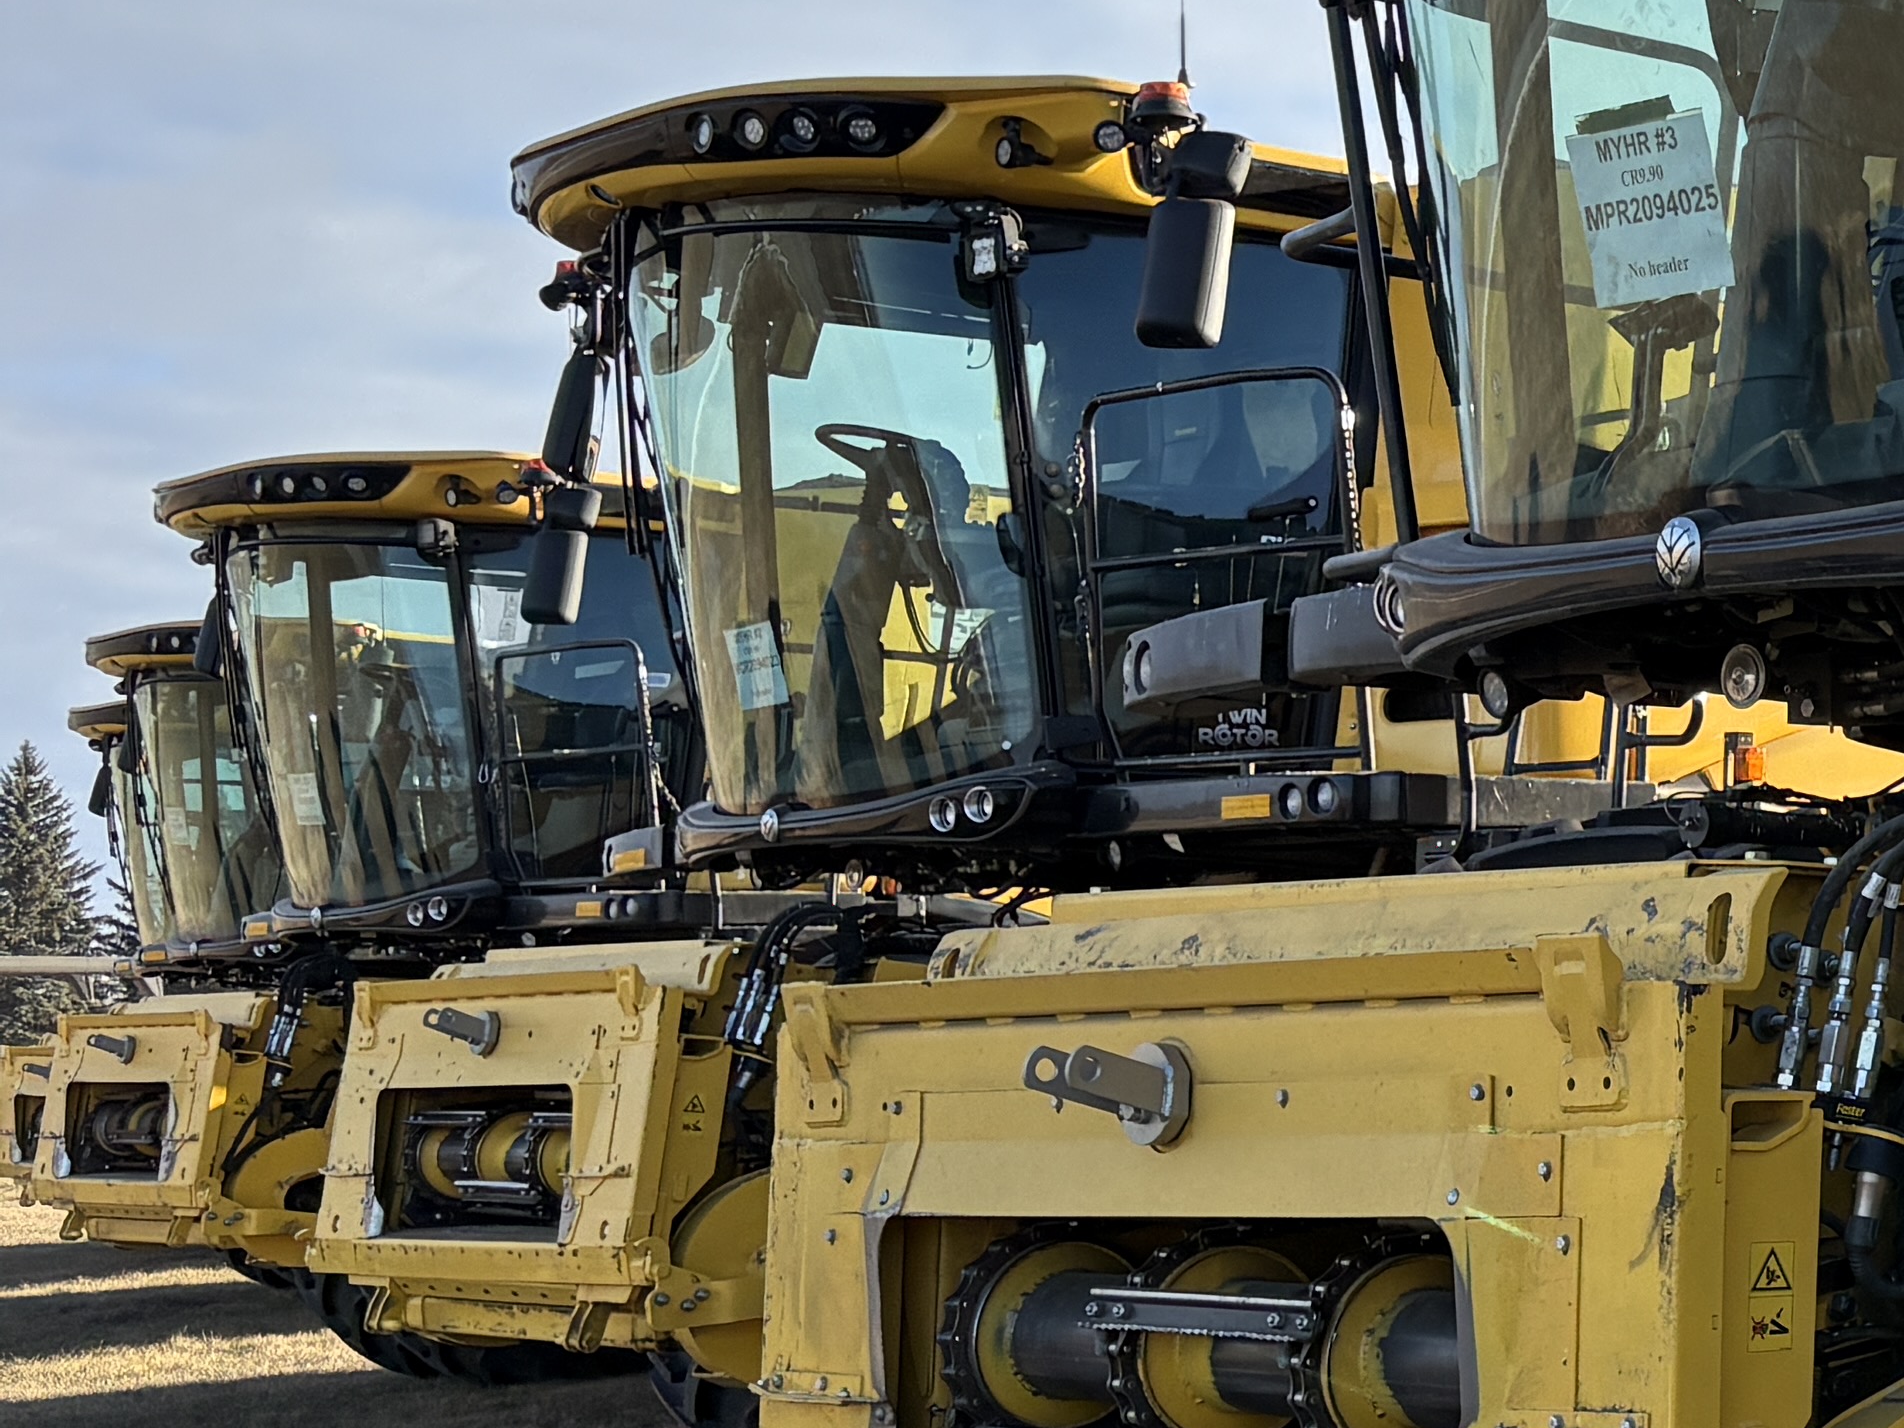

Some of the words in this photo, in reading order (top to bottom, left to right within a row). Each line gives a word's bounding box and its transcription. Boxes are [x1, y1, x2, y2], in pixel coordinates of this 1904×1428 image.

[1594, 131, 1652, 164] MYHR
[1654, 125, 1679, 154] #3
[1620, 164, 1665, 188] CR9.90
[1583, 182, 1720, 233] MPR2094025
[1627, 261, 1647, 280] No
[1647, 255, 1690, 277] header
[1198, 723, 1280, 747] ROTOR
